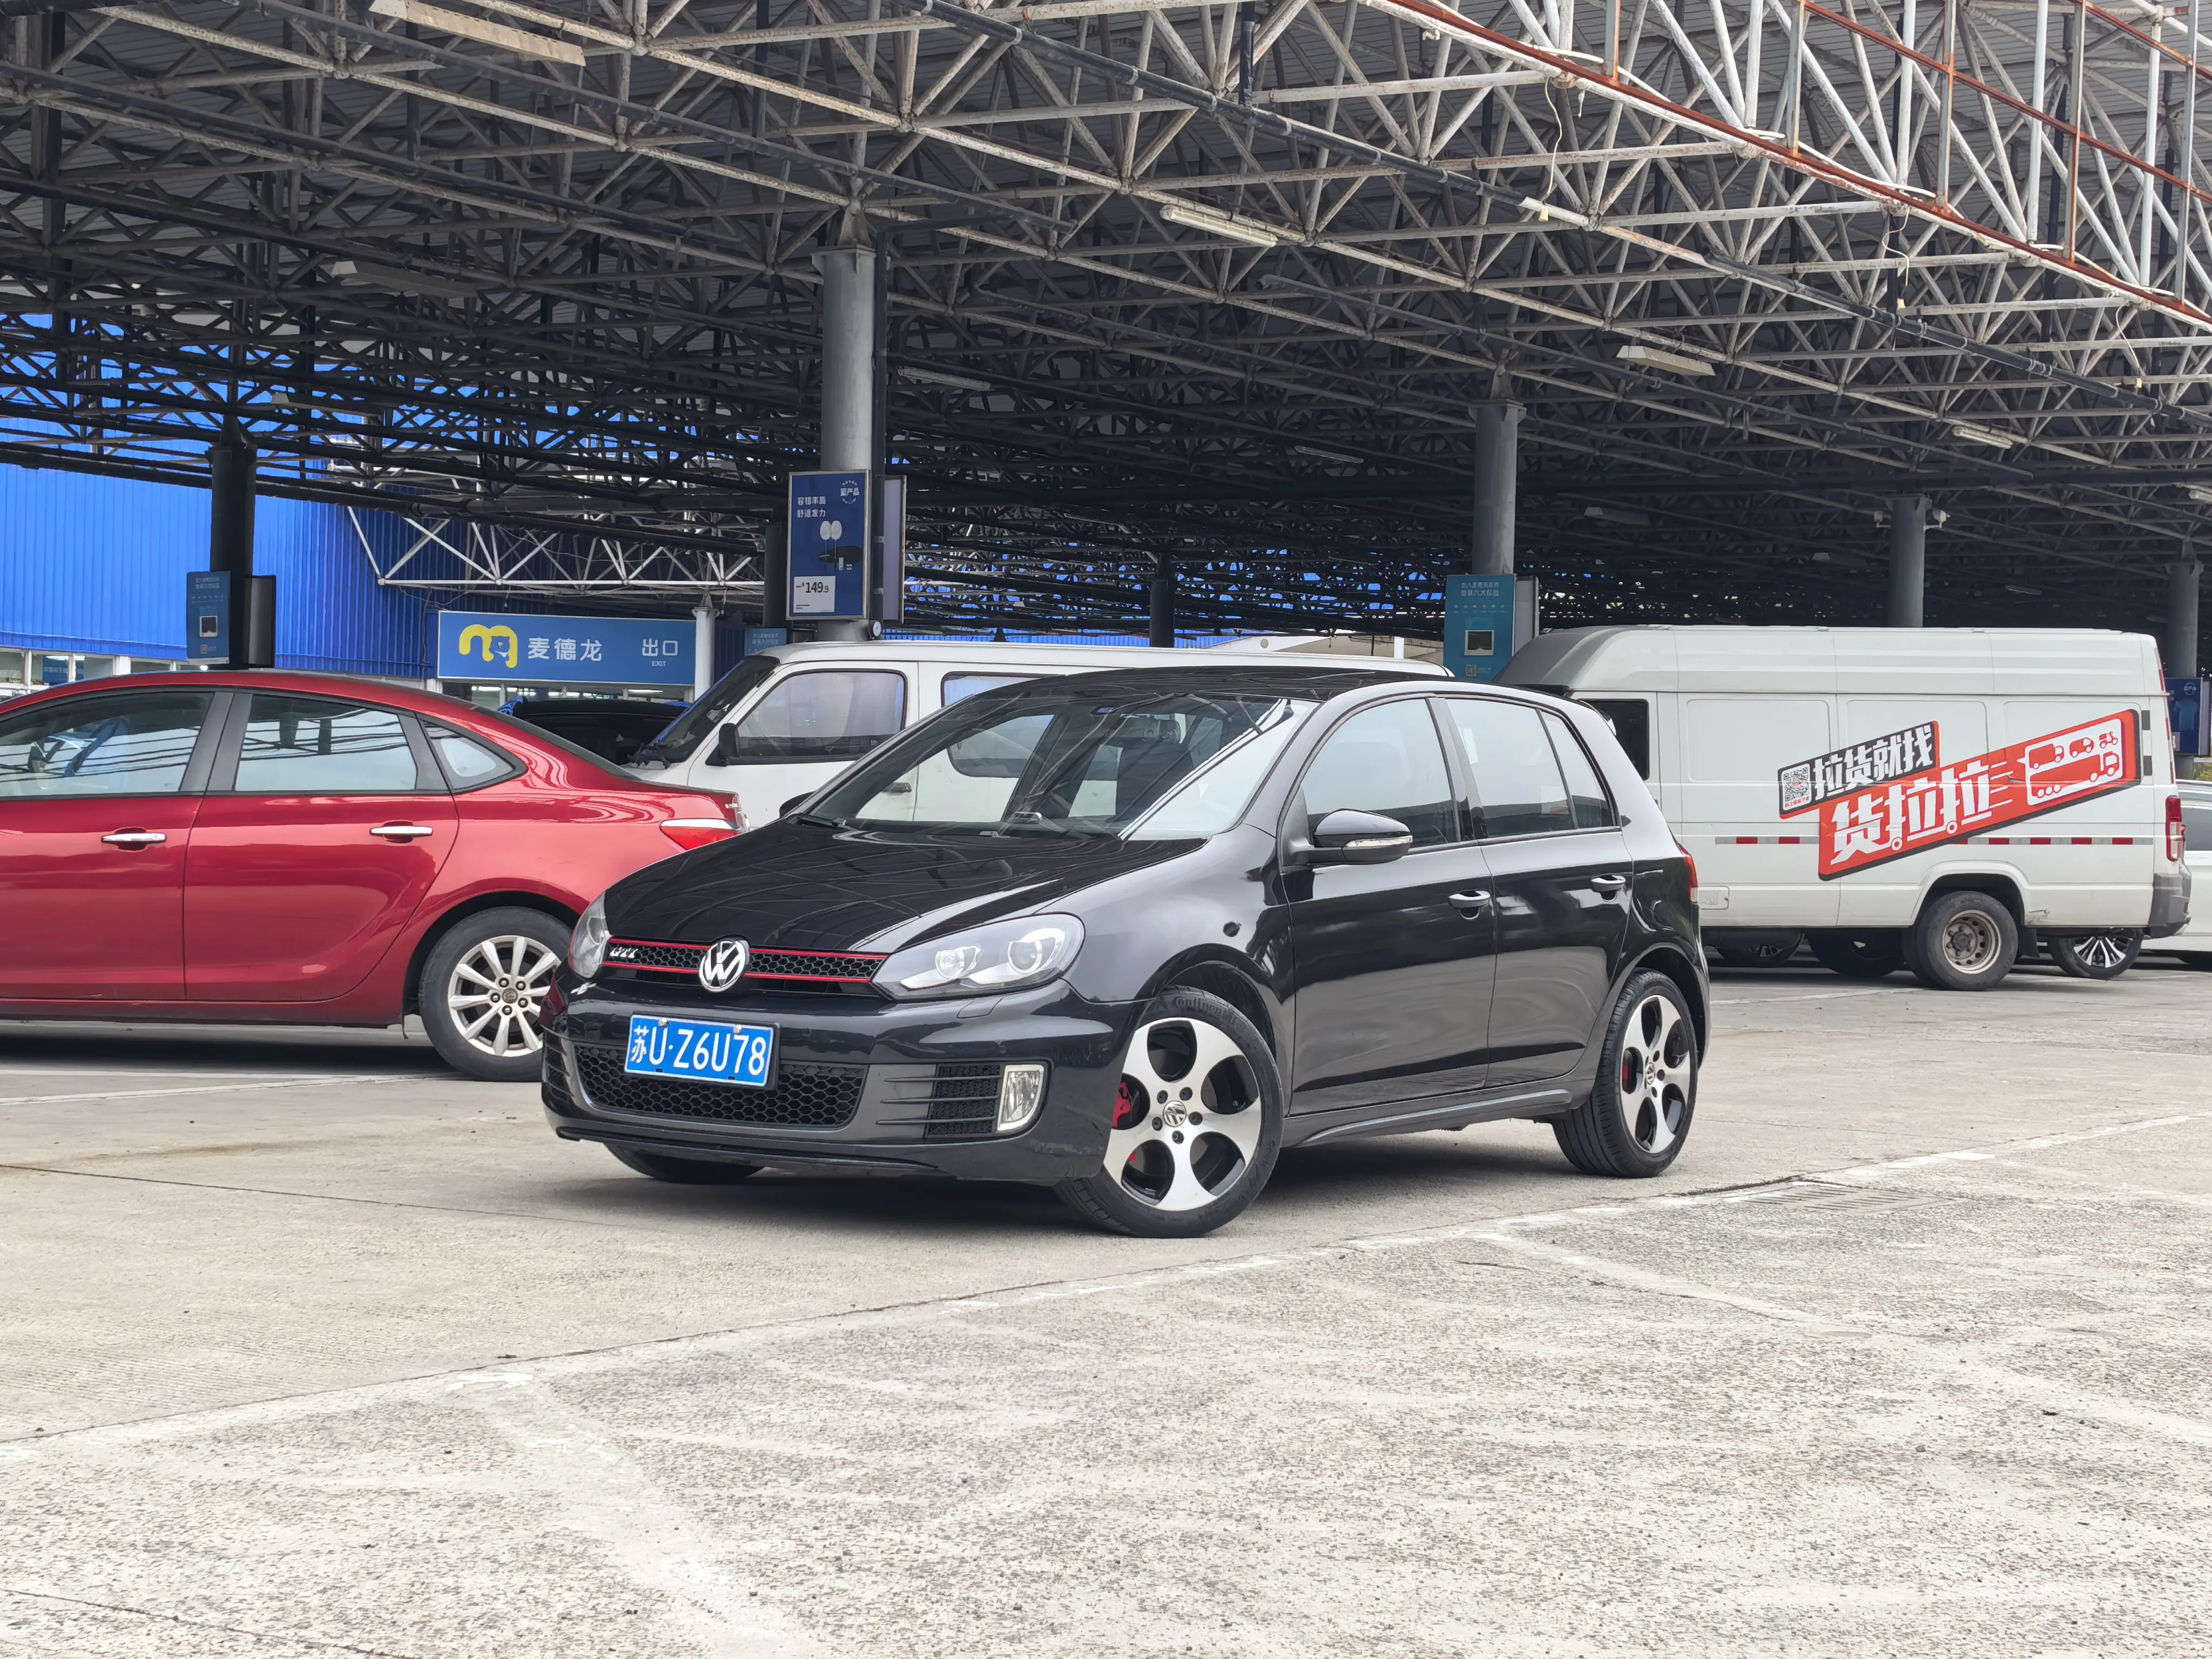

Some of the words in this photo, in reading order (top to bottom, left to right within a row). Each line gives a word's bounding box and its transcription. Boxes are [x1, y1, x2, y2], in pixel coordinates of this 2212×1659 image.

[527, 637, 602, 662] 麦德龙
[642, 638, 678, 656] 出口
[1813, 724, 1934, 799] 拉货就找
[1830, 761, 1992, 865] 货拉拉
